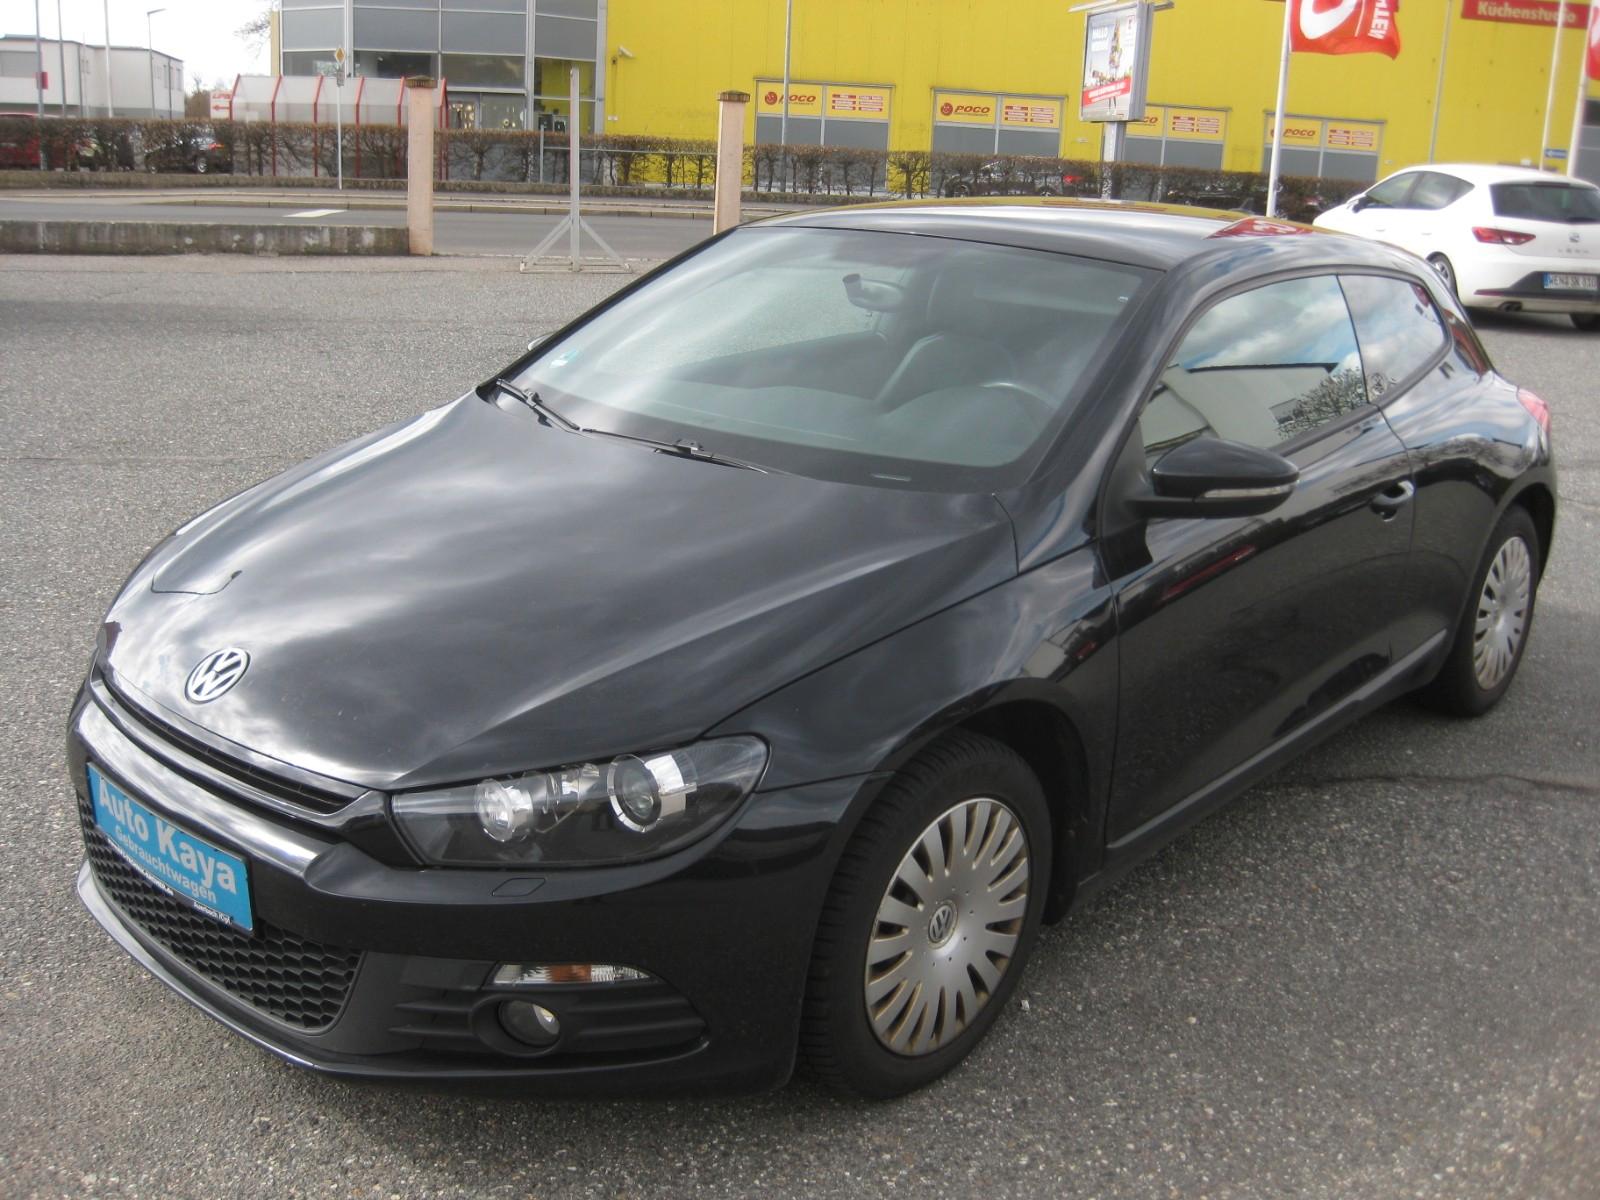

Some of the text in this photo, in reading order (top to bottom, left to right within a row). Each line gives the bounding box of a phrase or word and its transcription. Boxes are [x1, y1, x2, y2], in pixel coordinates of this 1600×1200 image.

[954, 105, 990, 114] POCO
[99, 777, 149, 842] Auto
[156, 818, 237, 895] Kaya
[114, 825, 217, 905] Gebrauchtwagen
